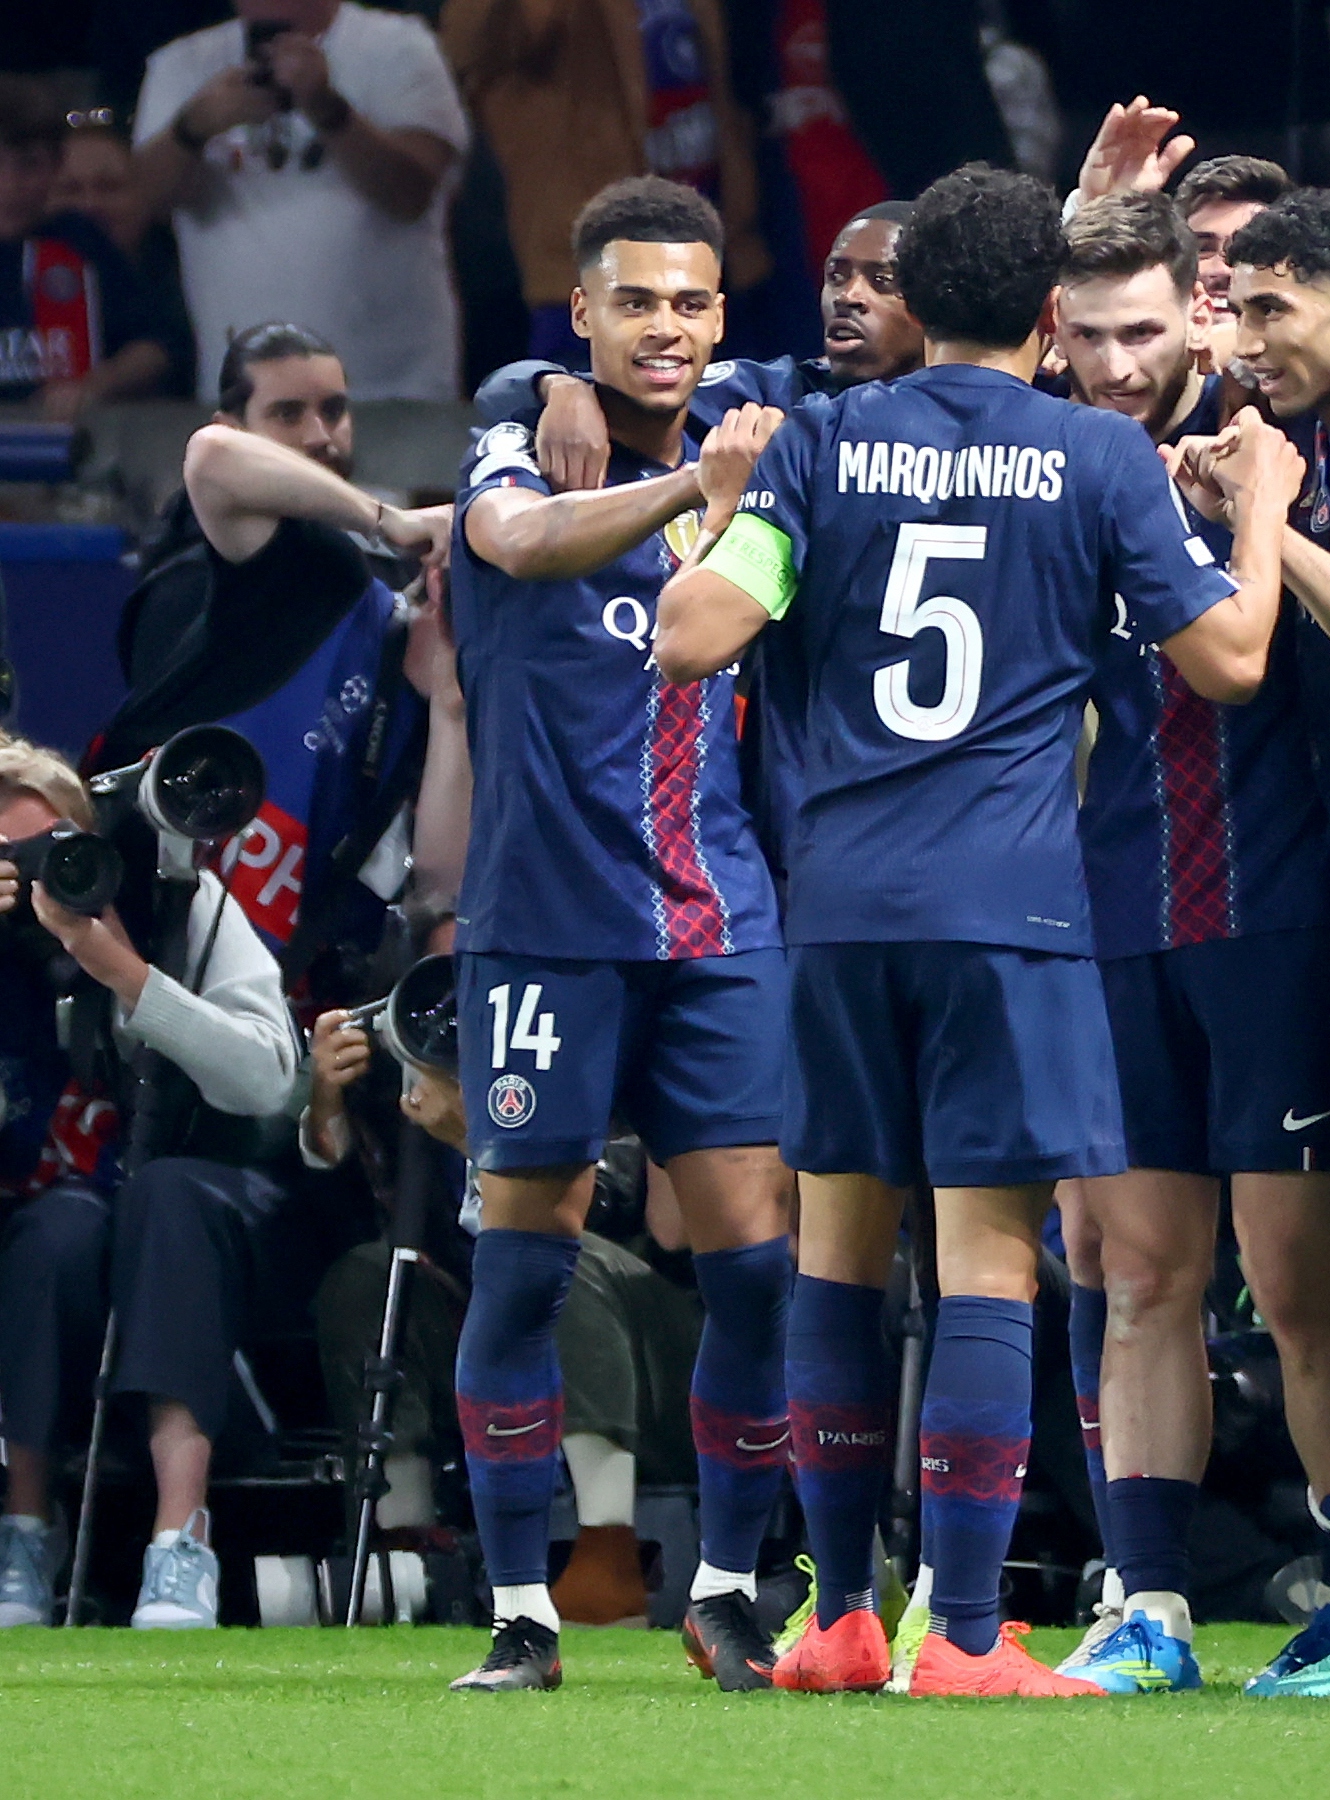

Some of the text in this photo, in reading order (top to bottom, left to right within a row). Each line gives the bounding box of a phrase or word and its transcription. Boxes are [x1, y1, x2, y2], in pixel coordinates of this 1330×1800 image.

[837, 441, 1066, 504] MARQUINHOS
[873, 522, 987, 742] 5
[488, 983, 562, 1071] 14
[817, 1429, 886, 1446] PARIS
